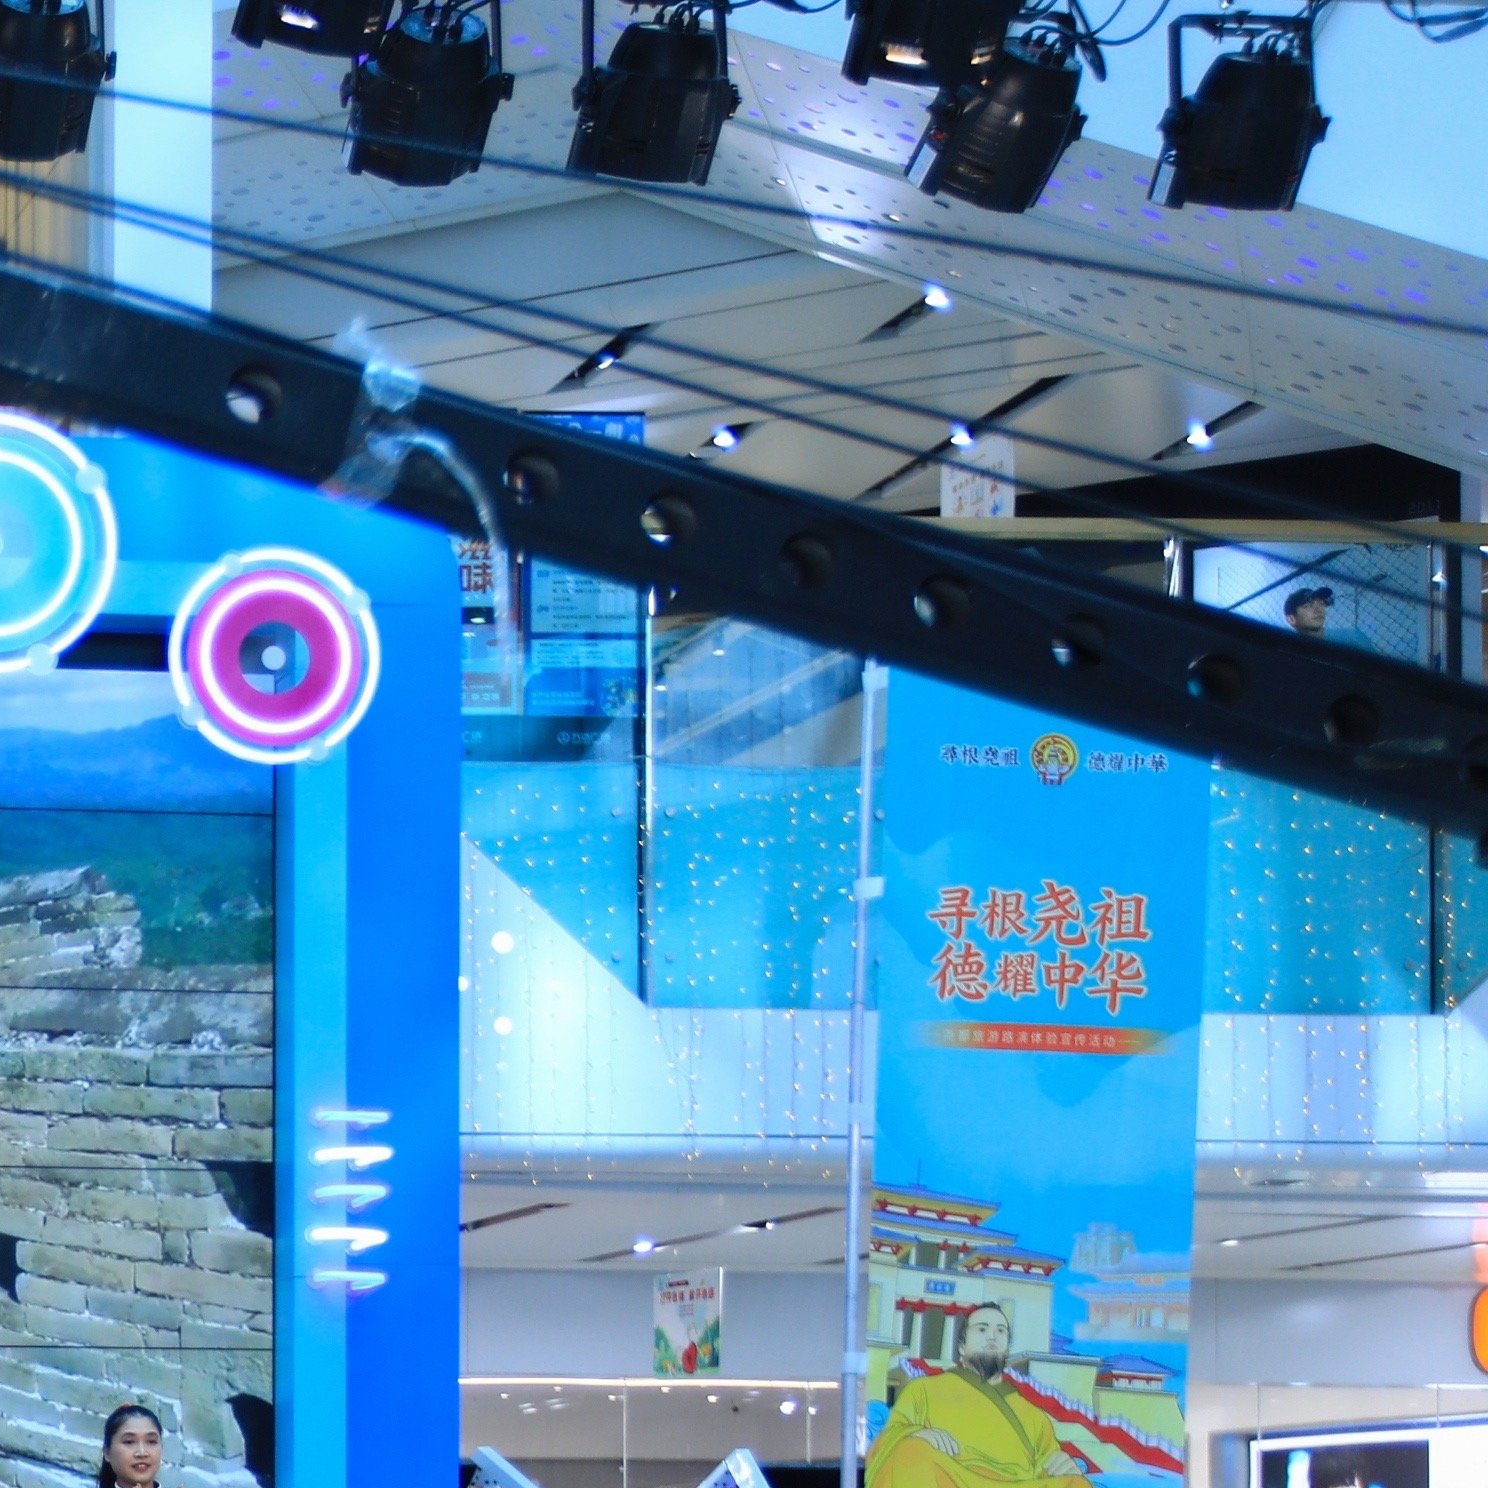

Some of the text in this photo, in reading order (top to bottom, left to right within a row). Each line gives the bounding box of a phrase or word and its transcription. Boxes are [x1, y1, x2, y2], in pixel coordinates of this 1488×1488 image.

[926, 879, 1153, 948] 寻根尧祖
[926, 940, 1148, 1015] 德耀中华
